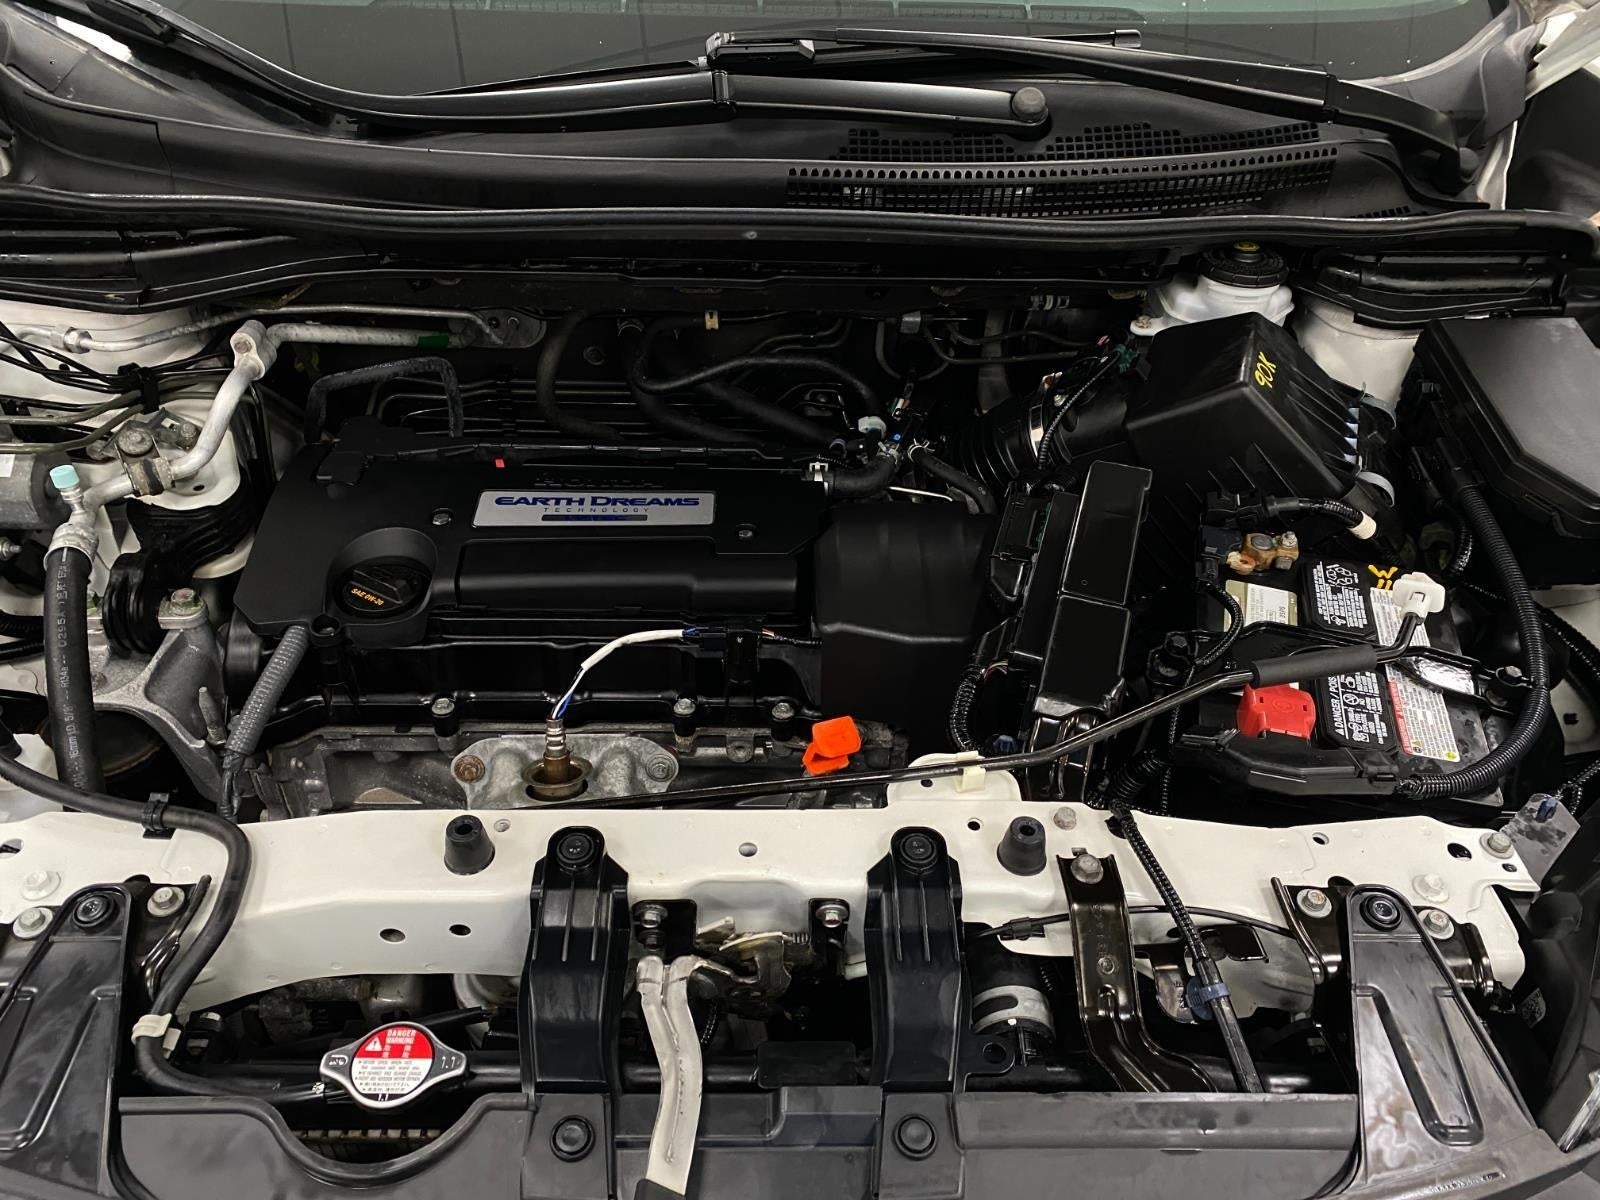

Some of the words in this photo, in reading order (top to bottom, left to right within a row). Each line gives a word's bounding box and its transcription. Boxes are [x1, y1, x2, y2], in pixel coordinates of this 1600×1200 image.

[1254, 351, 1277, 389] 90K
[494, 496, 587, 507] EARTH
[590, 495, 700, 507] DREAMS
[351, 588, 367, 598] SAE
[1327, 675, 1339, 693] POIS
[1330, 698, 1345, 729] DANGER
[386, 1029, 417, 1037] DANGER
[385, 1037, 415, 1045] WARNING
